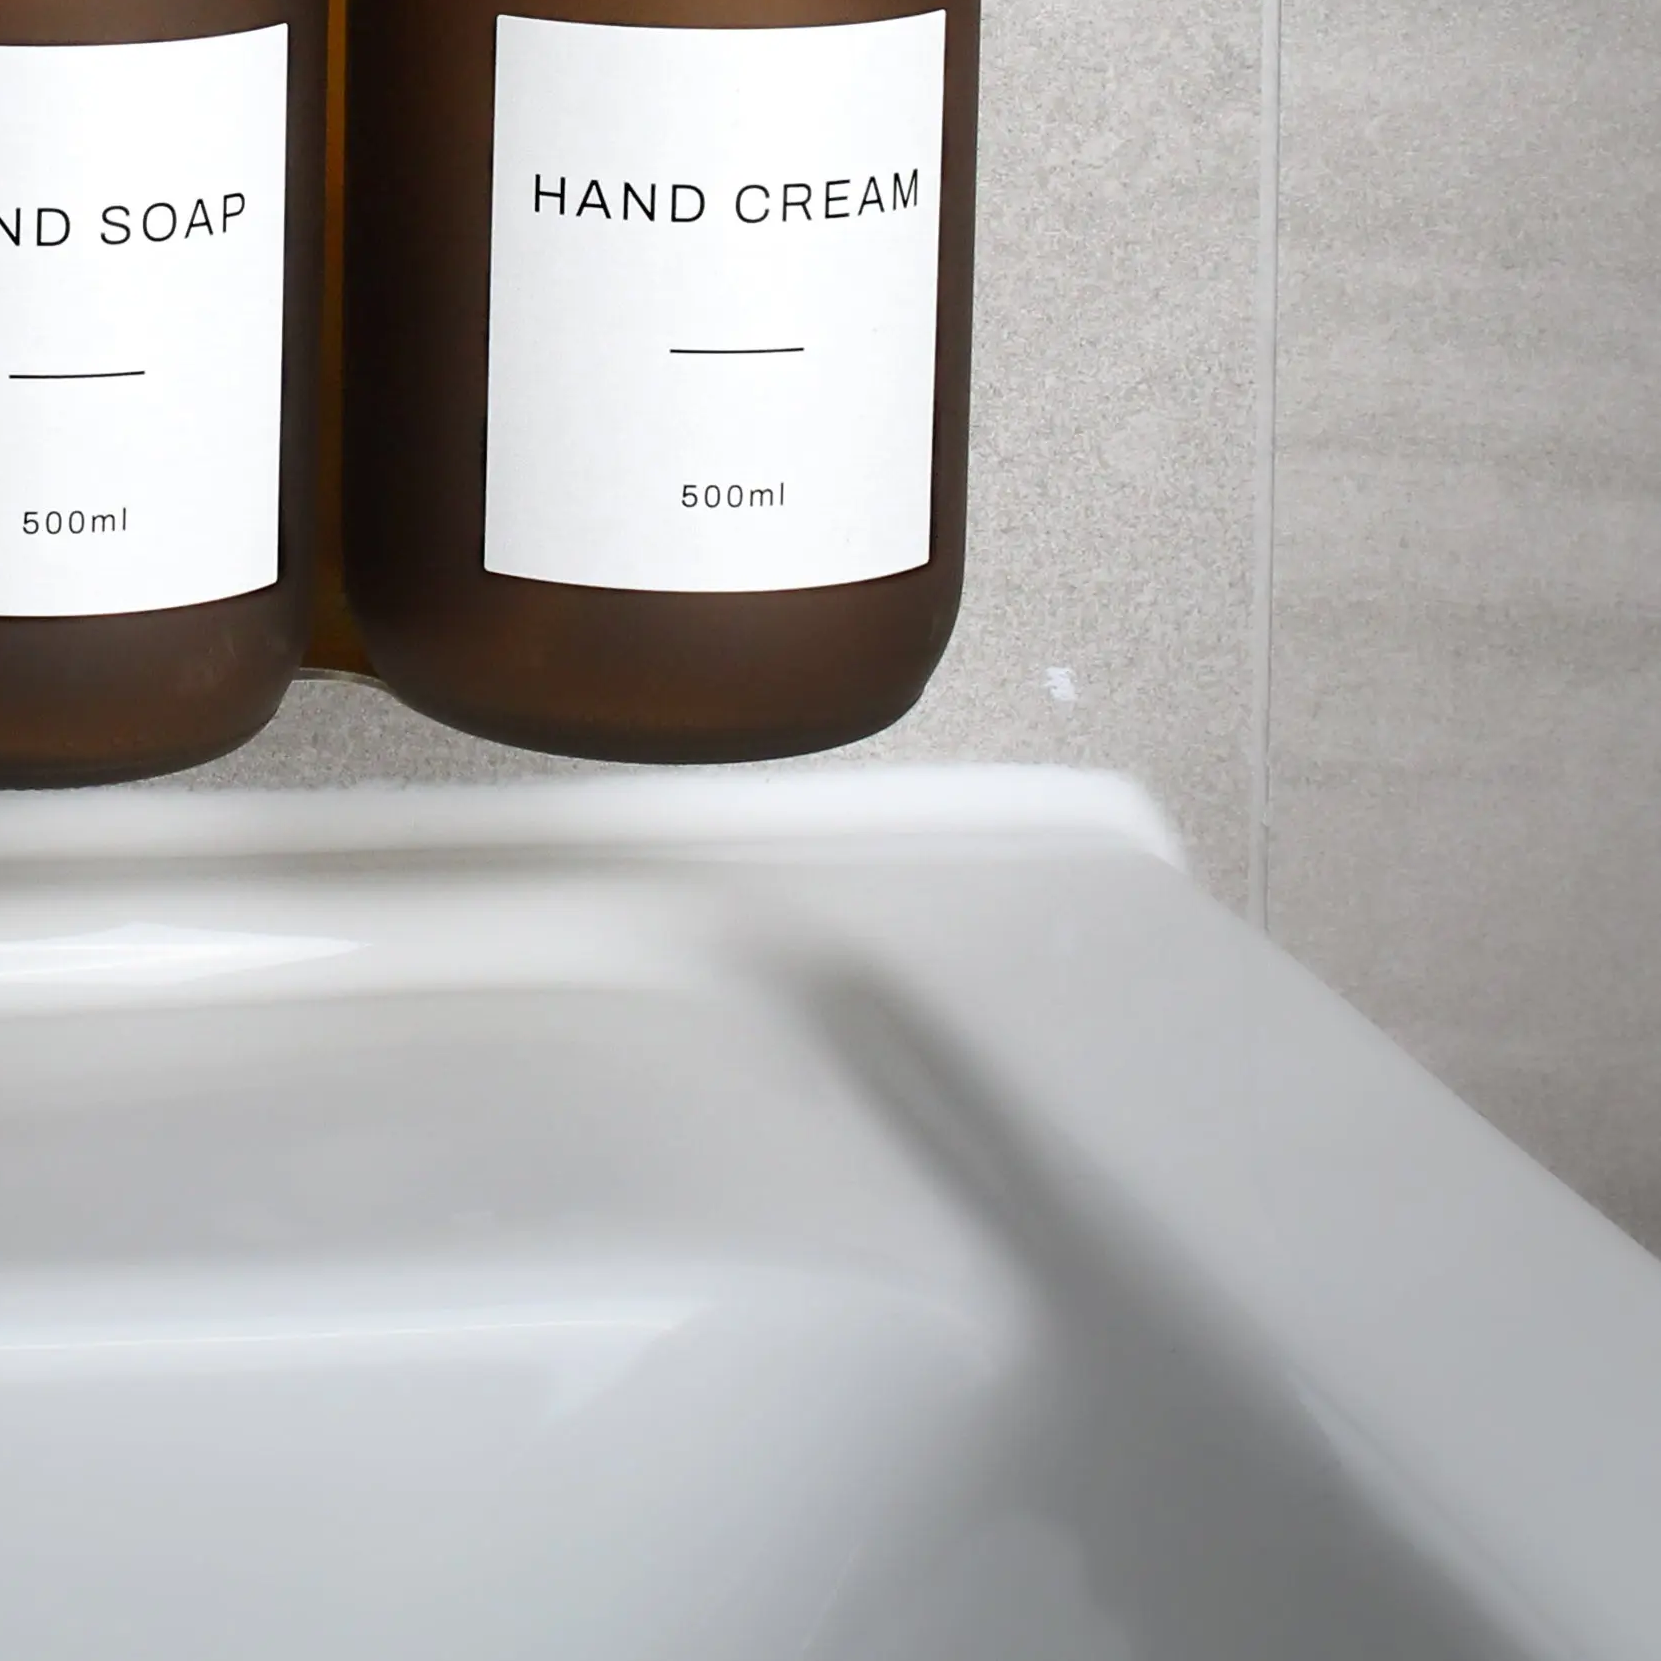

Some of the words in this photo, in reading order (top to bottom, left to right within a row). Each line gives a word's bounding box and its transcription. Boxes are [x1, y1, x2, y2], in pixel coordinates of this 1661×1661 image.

[534, 173, 706, 223] HAND
[735, 168, 919, 224] CREAM
[100, 192, 246, 245] SOAP
[681, 482, 785, 509] 500ml
[22, 507, 128, 535] 500ml
